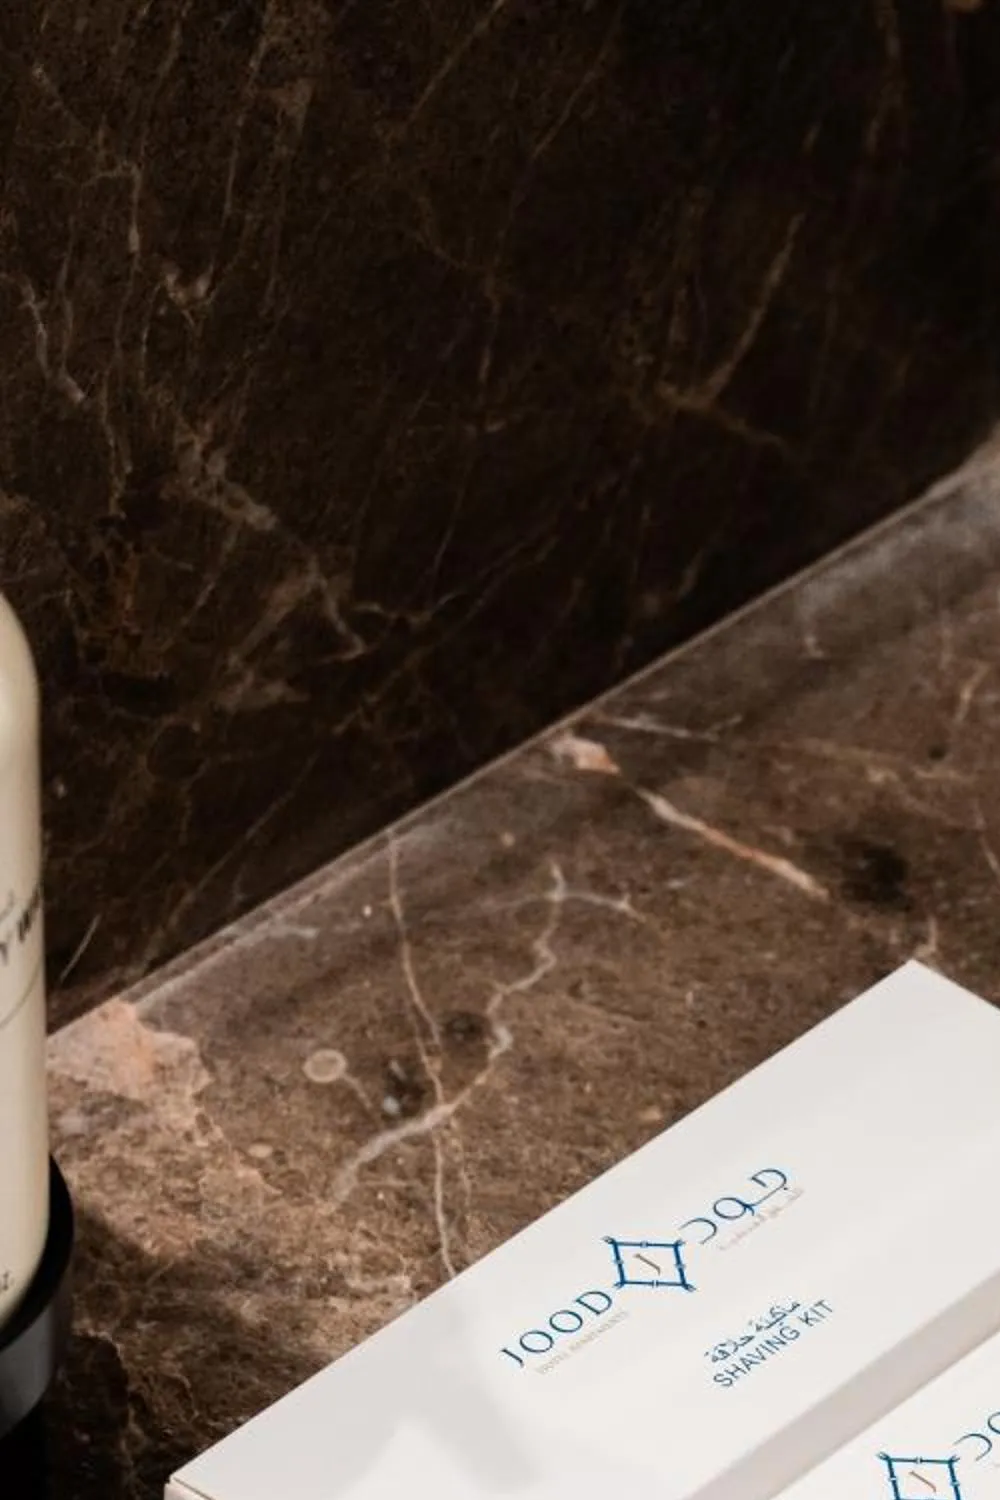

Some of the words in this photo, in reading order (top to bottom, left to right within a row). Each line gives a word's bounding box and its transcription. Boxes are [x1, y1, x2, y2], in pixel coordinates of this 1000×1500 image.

[678, 1168, 788, 1244] جود
[501, 1291, 613, 1368] JOOD
[713, 1325, 800, 1387] SHAVING
[798, 1299, 833, 1327] KIT
